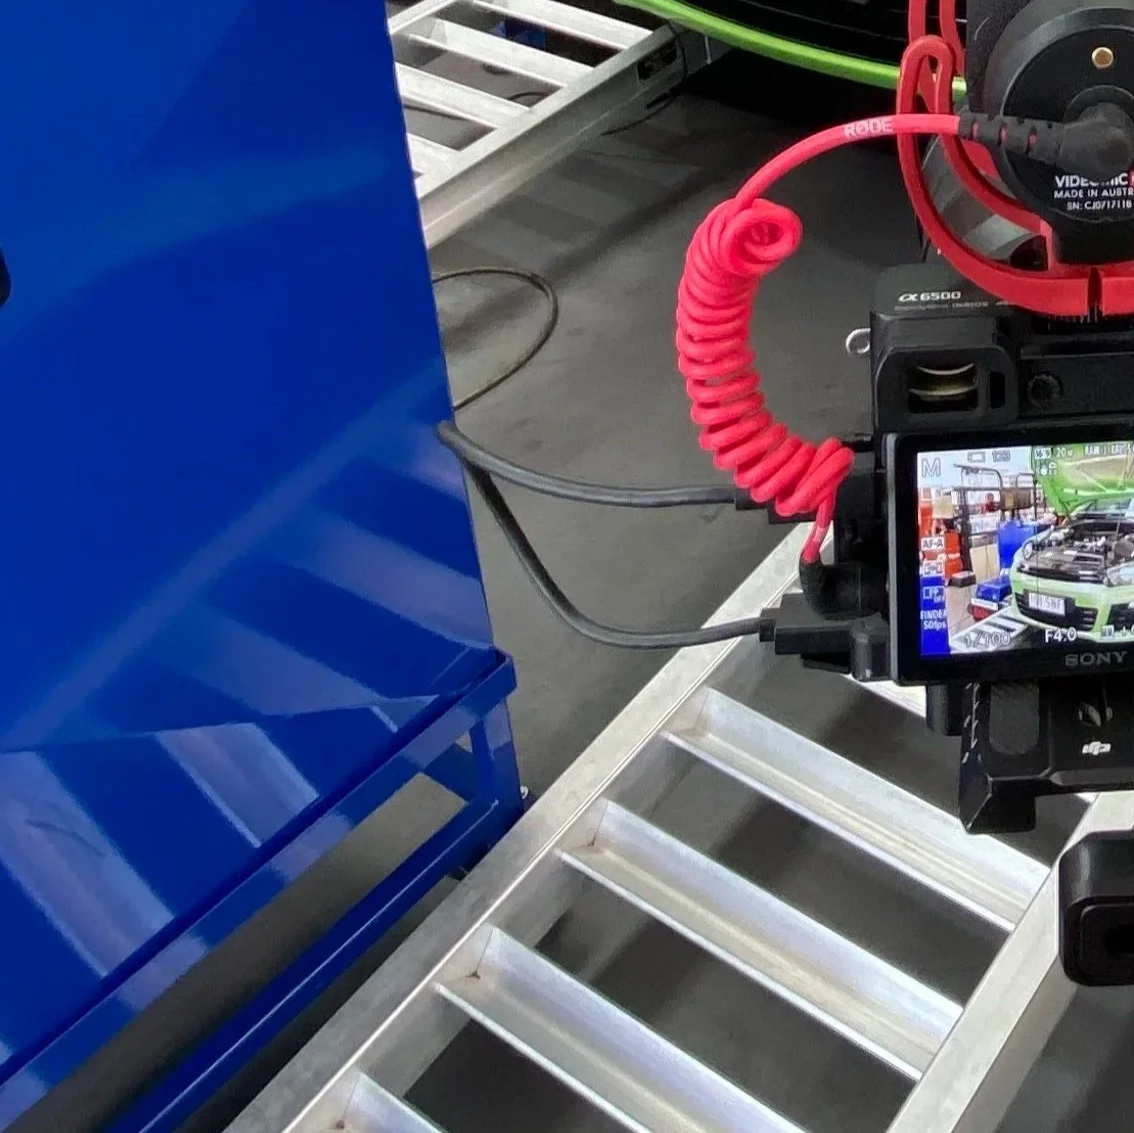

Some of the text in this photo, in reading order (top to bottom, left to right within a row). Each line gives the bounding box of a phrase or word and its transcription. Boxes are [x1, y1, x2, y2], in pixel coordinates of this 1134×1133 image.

[1054, 189, 1083, 199] MADE
[1088, 188, 1098, 197] IN
[1044, 627, 1077, 643] F4.0
[1065, 650, 1127, 667] SONY
